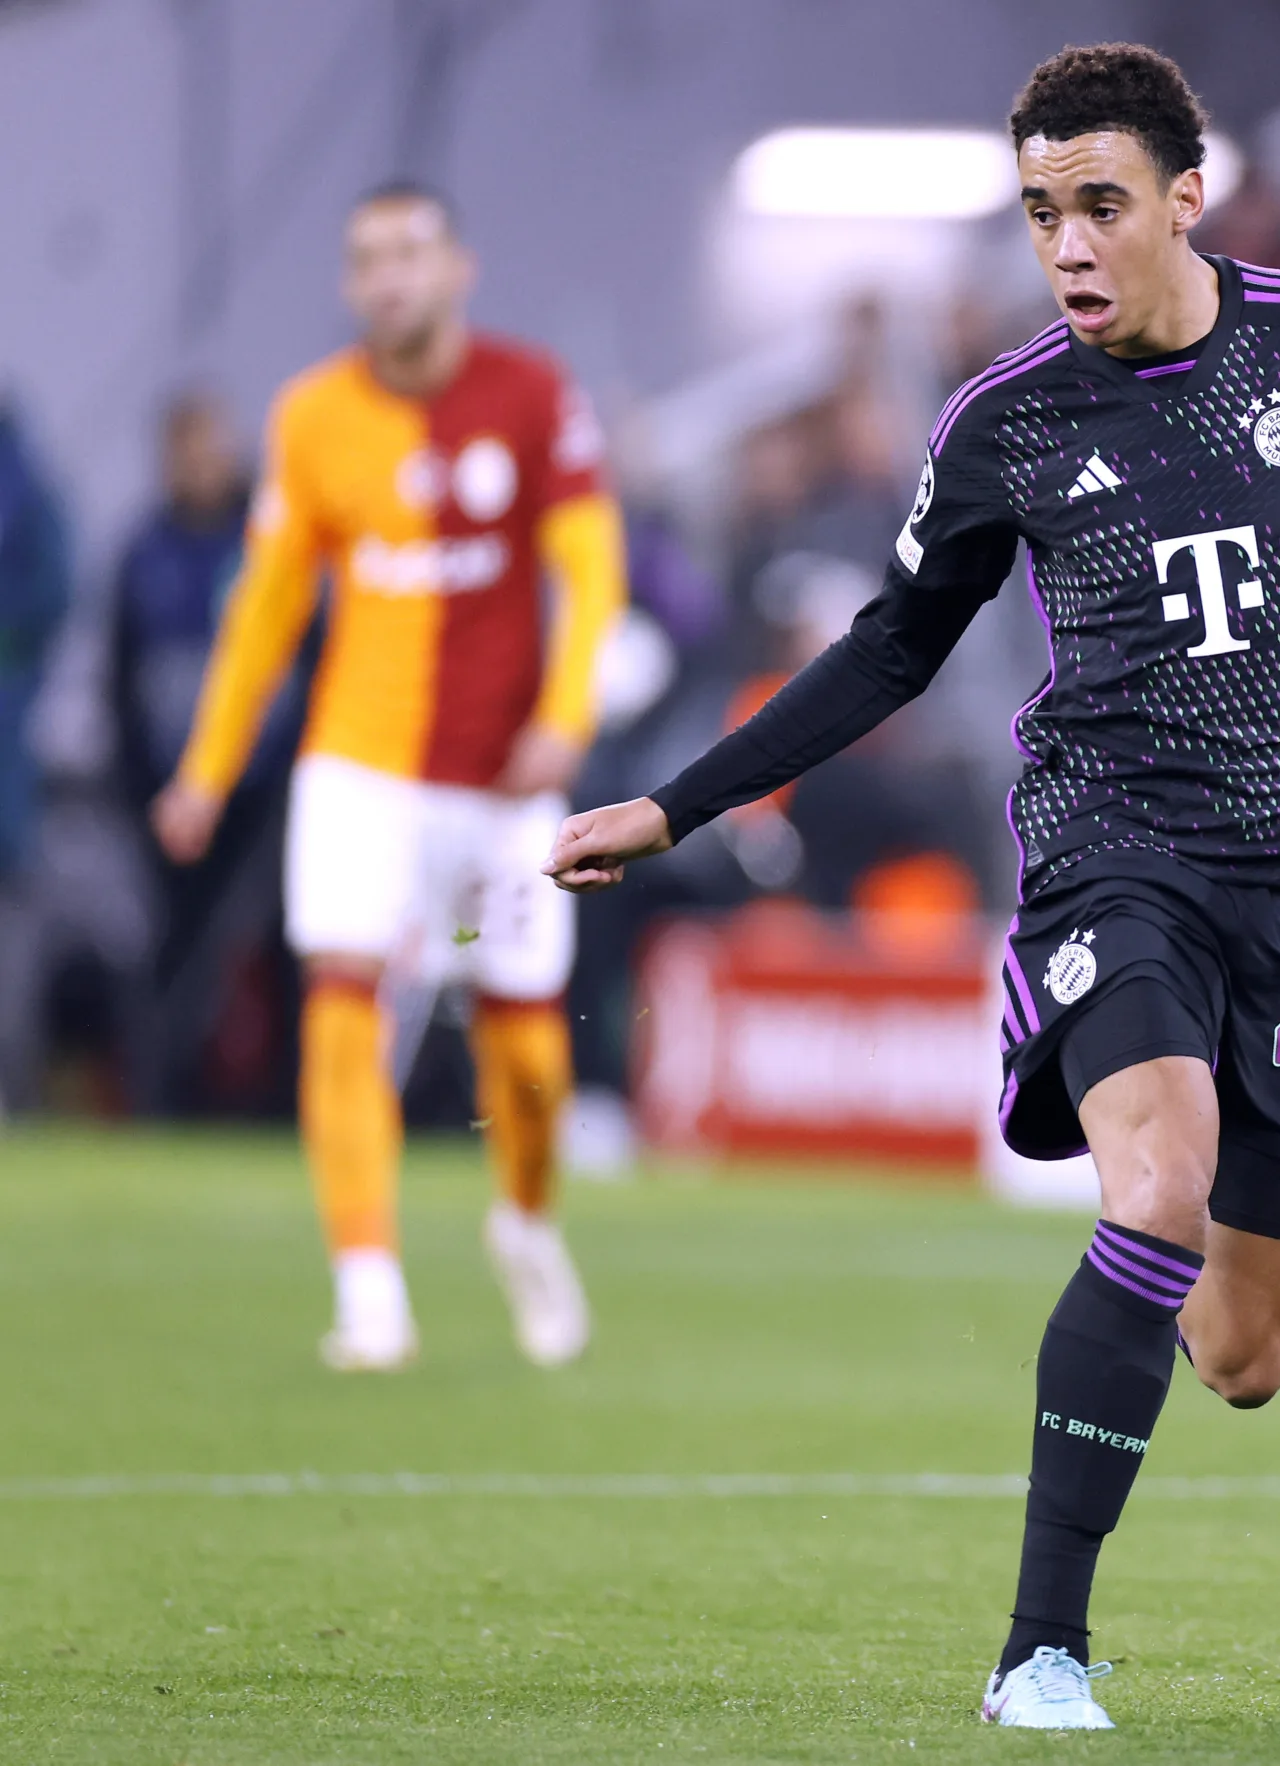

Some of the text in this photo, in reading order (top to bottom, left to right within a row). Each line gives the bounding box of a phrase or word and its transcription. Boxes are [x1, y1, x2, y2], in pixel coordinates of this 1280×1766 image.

[1260, 423, 1269, 436] FC
[1041, 1411, 1150, 1453] FC BAYERN
